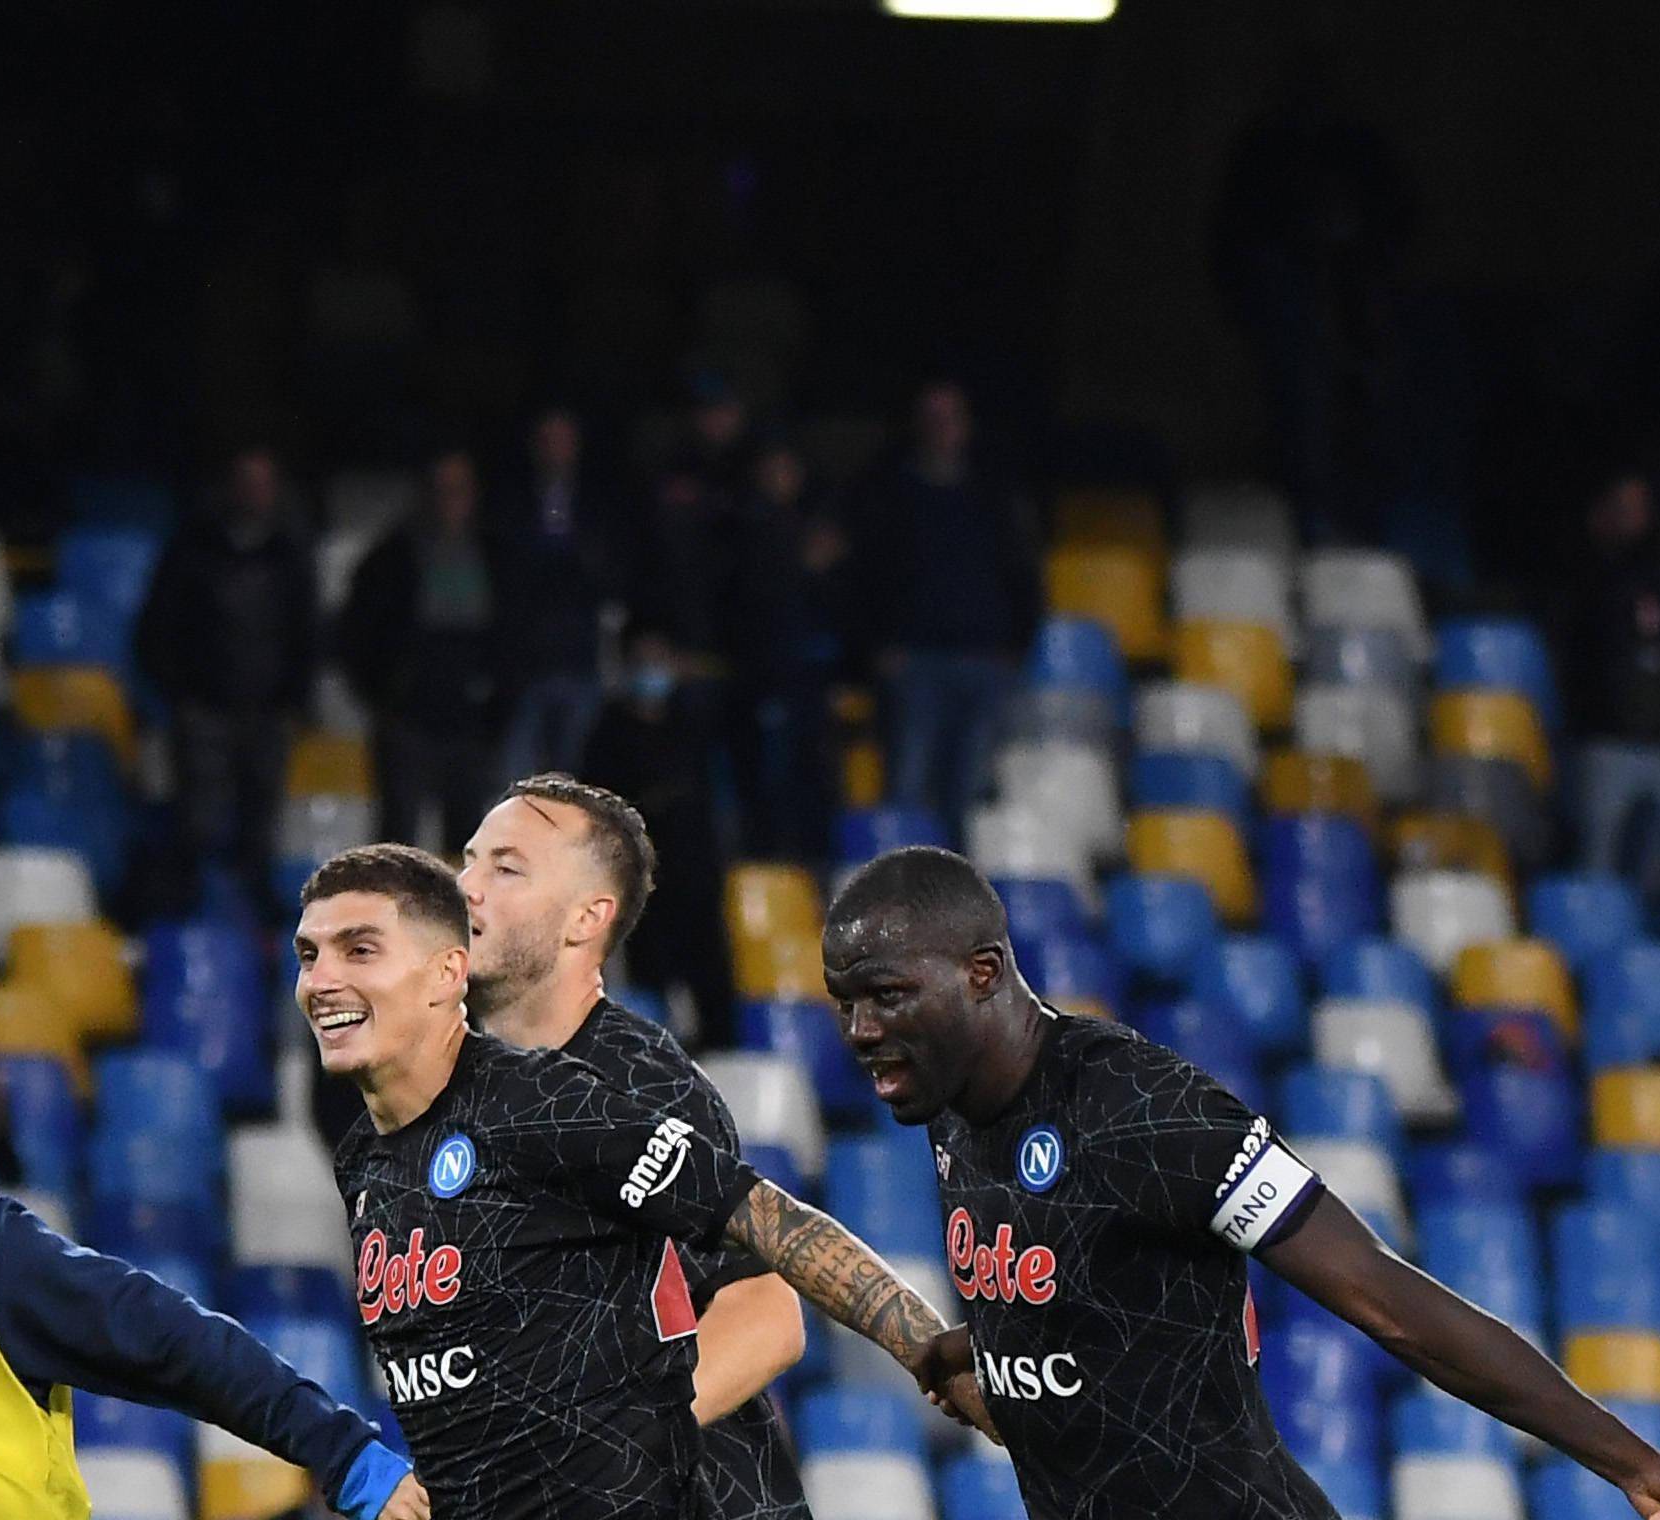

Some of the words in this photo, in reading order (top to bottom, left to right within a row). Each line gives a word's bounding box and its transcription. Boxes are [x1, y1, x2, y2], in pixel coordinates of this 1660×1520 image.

[440, 1151, 464, 1181] N
[1028, 1142, 1053, 1174] N
[1222, 1181, 1278, 1242] TANO
[357, 1228, 462, 1325] Lete
[946, 1206, 1057, 1305] Lete
[388, 1345, 478, 1403] MSC
[982, 1351, 1083, 1400] MSC
